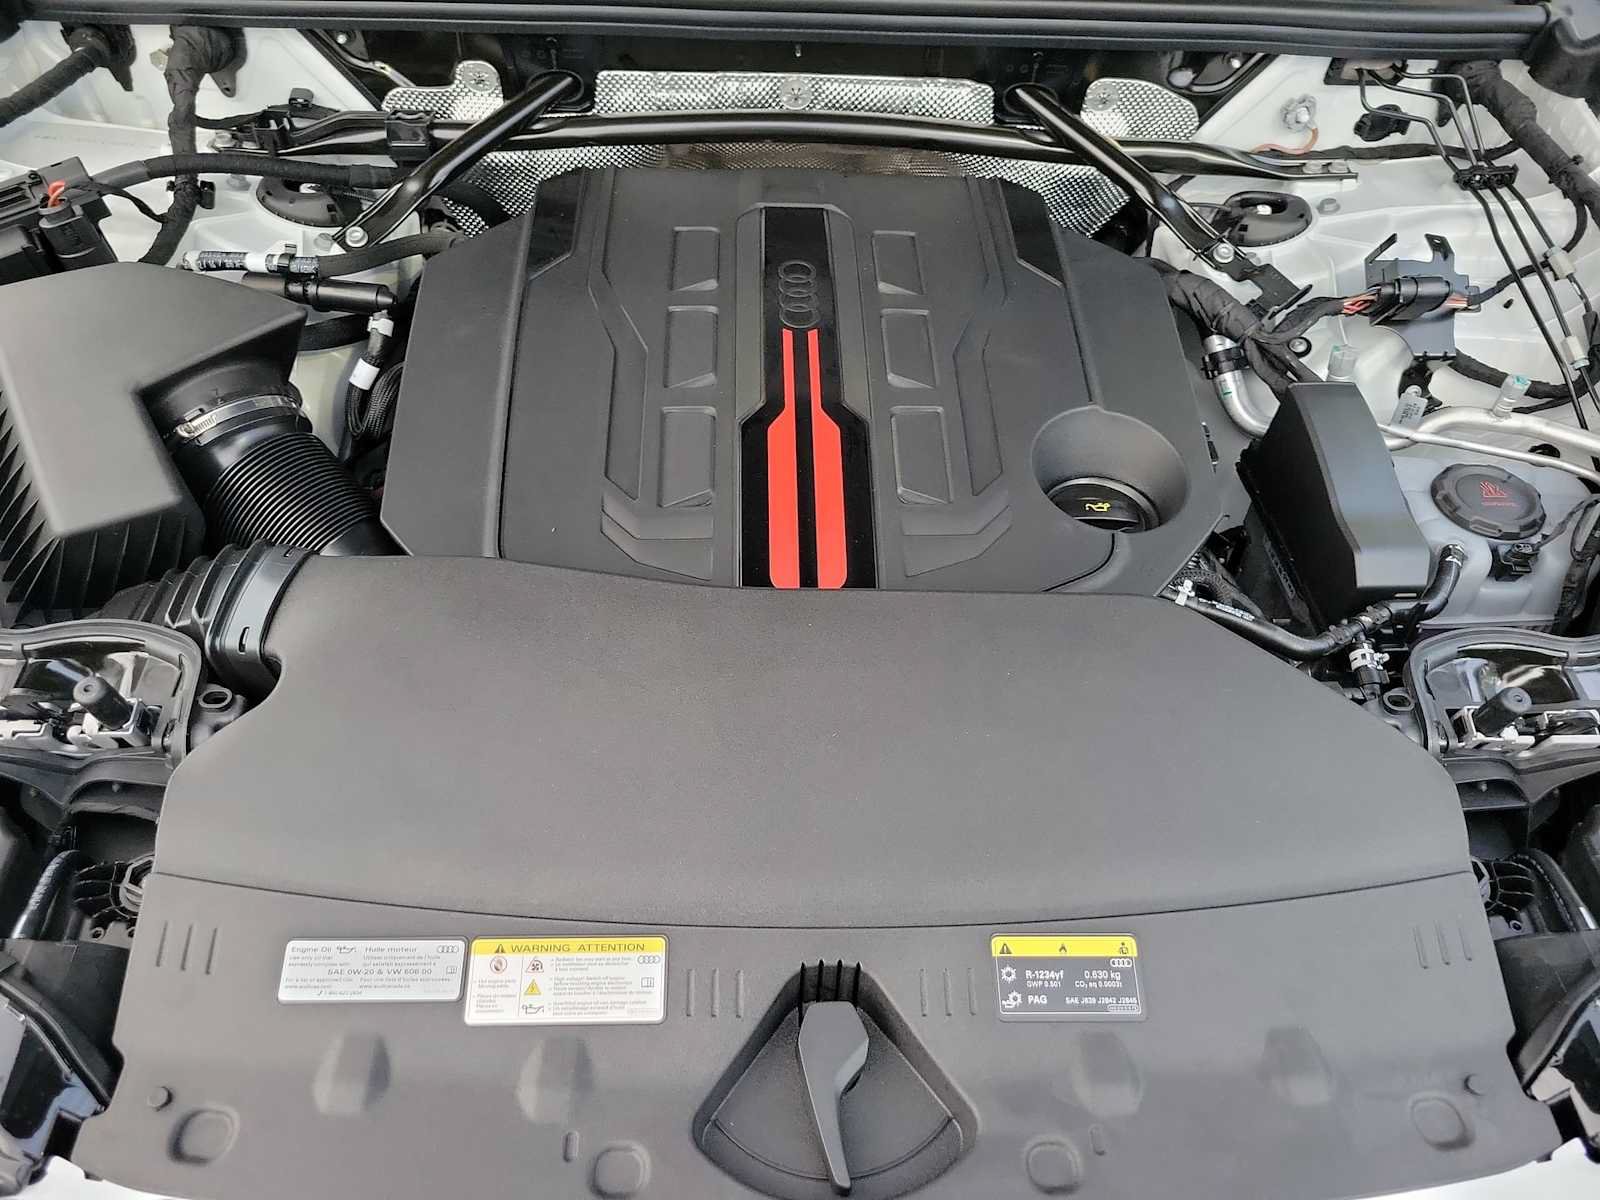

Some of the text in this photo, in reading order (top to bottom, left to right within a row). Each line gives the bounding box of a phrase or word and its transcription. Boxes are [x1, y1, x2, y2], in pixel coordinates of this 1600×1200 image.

[291, 946, 318, 954] Engine
[511, 943, 645, 953] WARNING ATTENTION
[1025, 970, 1064, 980] R-1234yf
[1110, 970, 1121, 980] kg
[1028, 995, 1047, 1004] PAG
